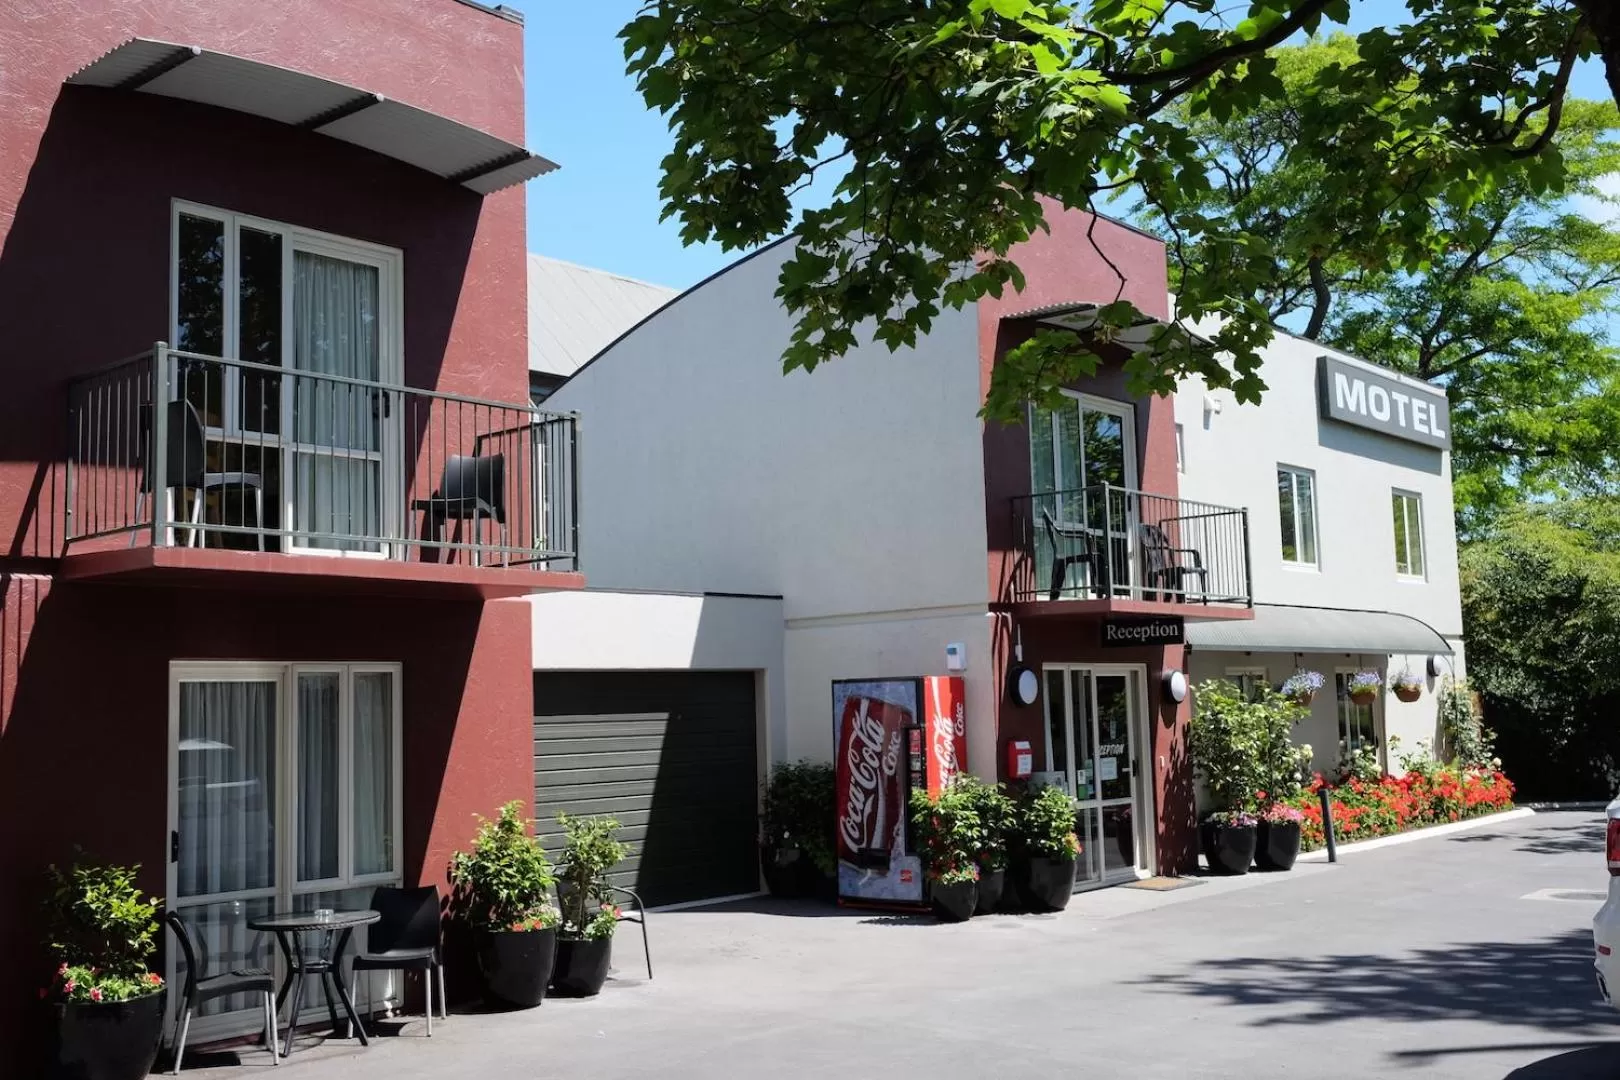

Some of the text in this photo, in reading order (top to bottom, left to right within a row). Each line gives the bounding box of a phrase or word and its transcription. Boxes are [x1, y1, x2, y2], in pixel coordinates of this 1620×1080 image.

[1335, 372, 1446, 439] MOTEL
[1106, 620, 1179, 642] Reception
[840, 708, 885, 853] Coca-Cola
[881, 731, 901, 776] Coke
